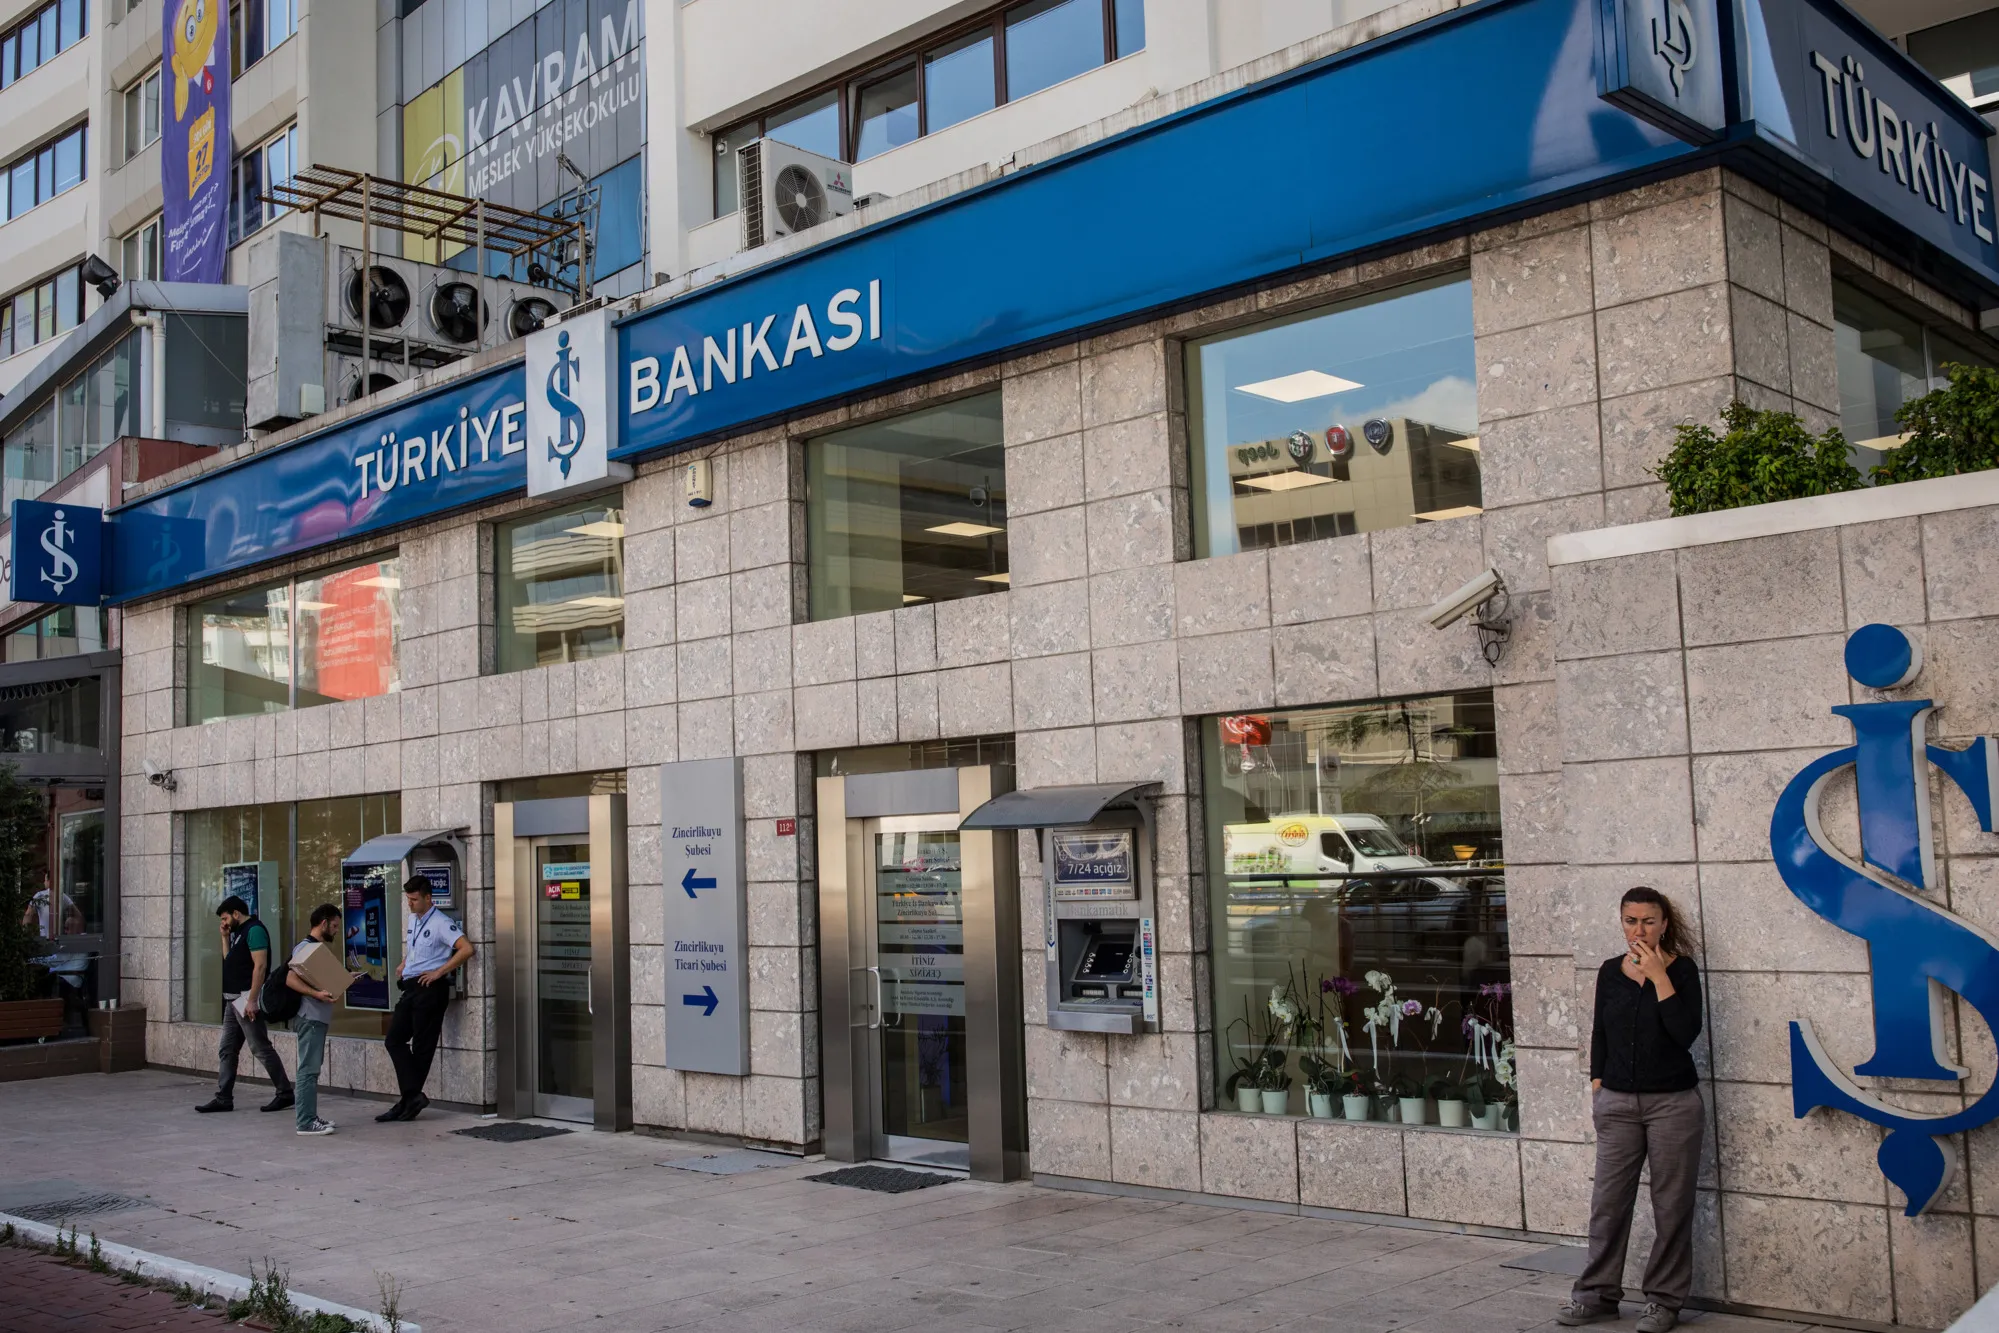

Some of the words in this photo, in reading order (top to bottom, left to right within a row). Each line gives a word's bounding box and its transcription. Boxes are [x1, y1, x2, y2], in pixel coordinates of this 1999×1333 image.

[467, 0, 640, 167] KAVRAM
[468, 144, 521, 199] MESLEK
[524, 72, 640, 164] YÜKSEKOKULU
[1810, 50, 1992, 244] TÜRKİYE
[195, 141, 209, 173] 27
[355, 400, 527, 499] TÜRKİYE
[631, 279, 882, 415] BANKASI
[672, 826, 722, 839] Zincirlikuyu
[685, 844, 711, 858] Şubesi
[1068, 863, 1091, 874] 7/24
[1093, 862, 1125, 876] açığız.
[1067, 902, 1128, 917] Bankamatik
[674, 940, 724, 955] Zincirlikuyu
[675, 959, 698, 970] Ticari
[700, 960, 727, 973] Şubesi
